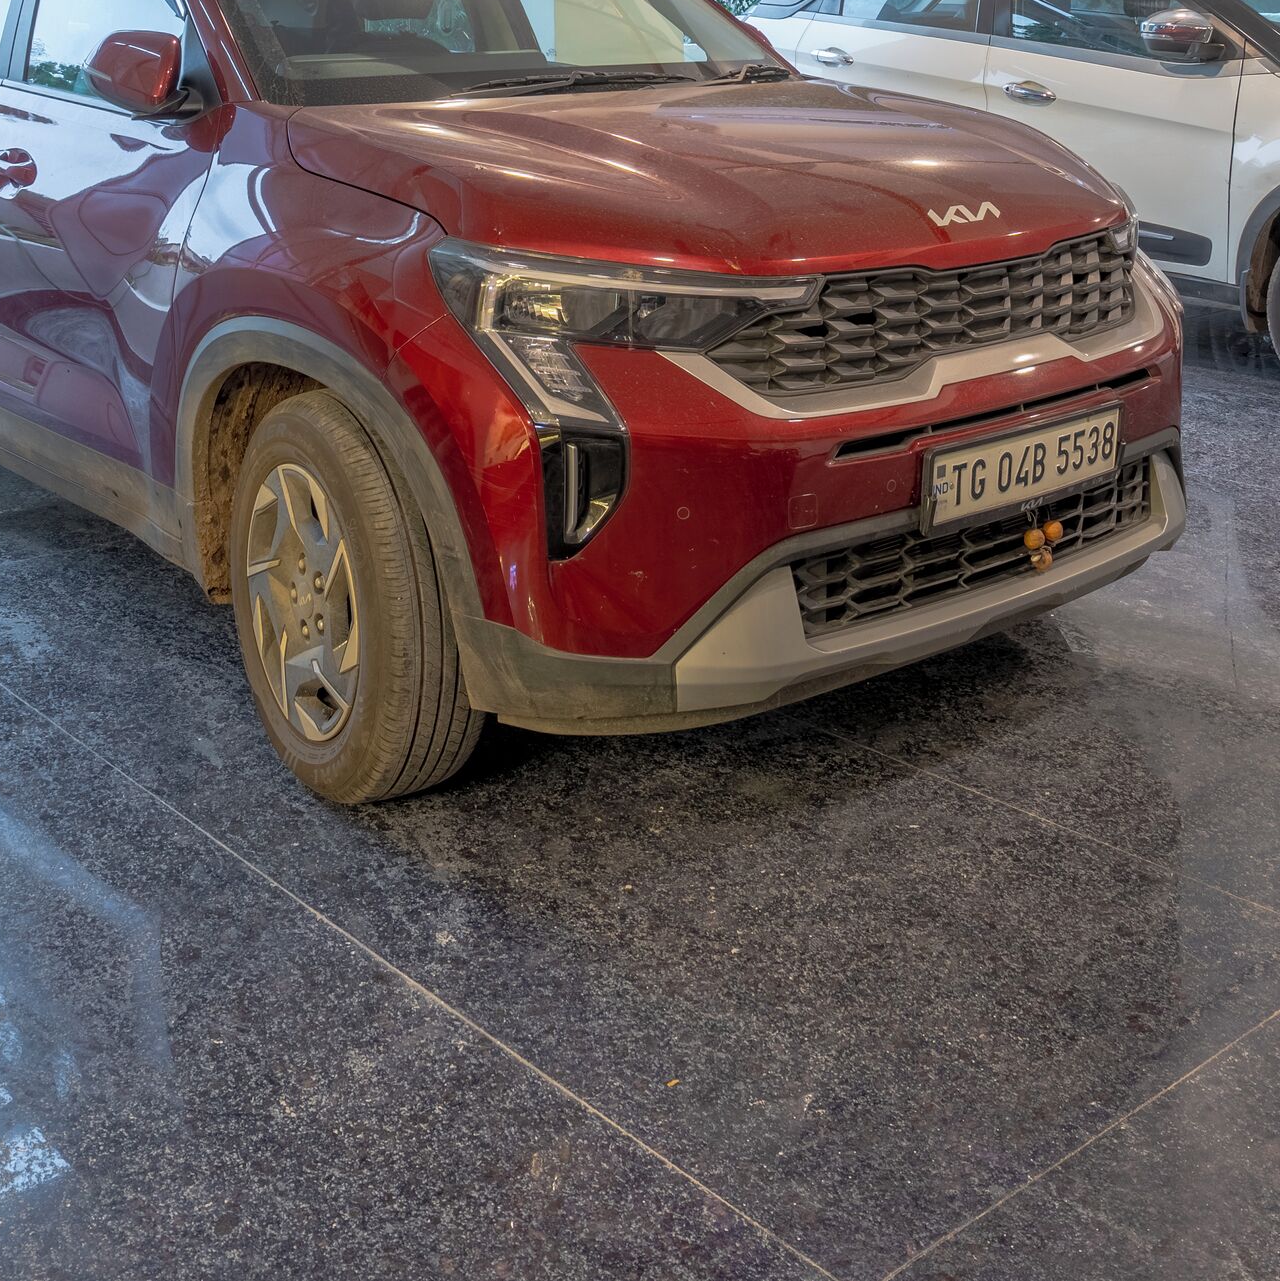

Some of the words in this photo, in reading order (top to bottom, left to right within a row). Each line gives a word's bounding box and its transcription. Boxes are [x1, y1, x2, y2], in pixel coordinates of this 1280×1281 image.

[927, 201, 1001, 227] KIA
[952, 458, 986, 506] TG
[997, 442, 1047, 493] 04B
[1056, 421, 1115, 475] 5538
